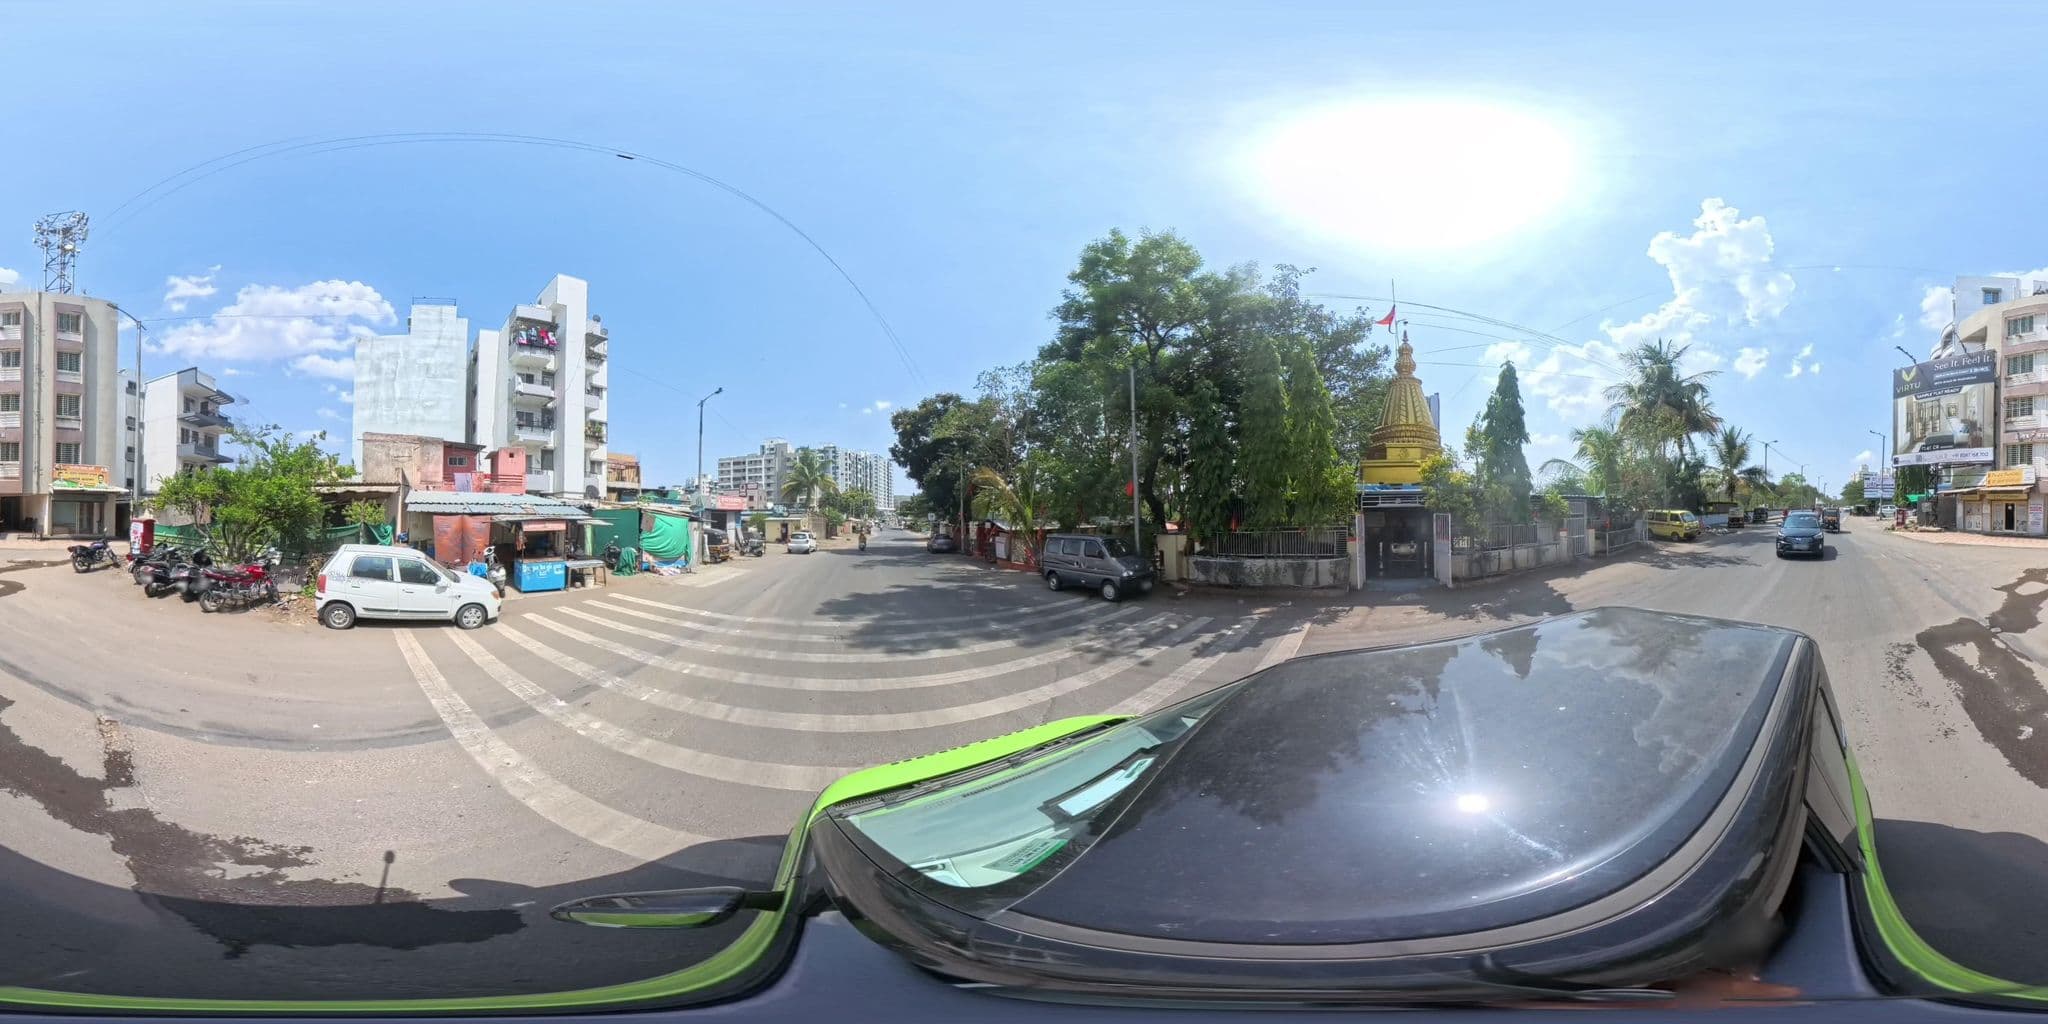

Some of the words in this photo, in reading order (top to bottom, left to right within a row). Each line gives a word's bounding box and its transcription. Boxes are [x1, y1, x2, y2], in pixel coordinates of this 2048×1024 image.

[1934, 361, 1949, 371] See
[1951, 359, 1960, 368] It.
[1962, 355, 1981, 366] Feel
[1983, 354, 1992, 363] It.
[1896, 381, 1921, 393] VIRTU
